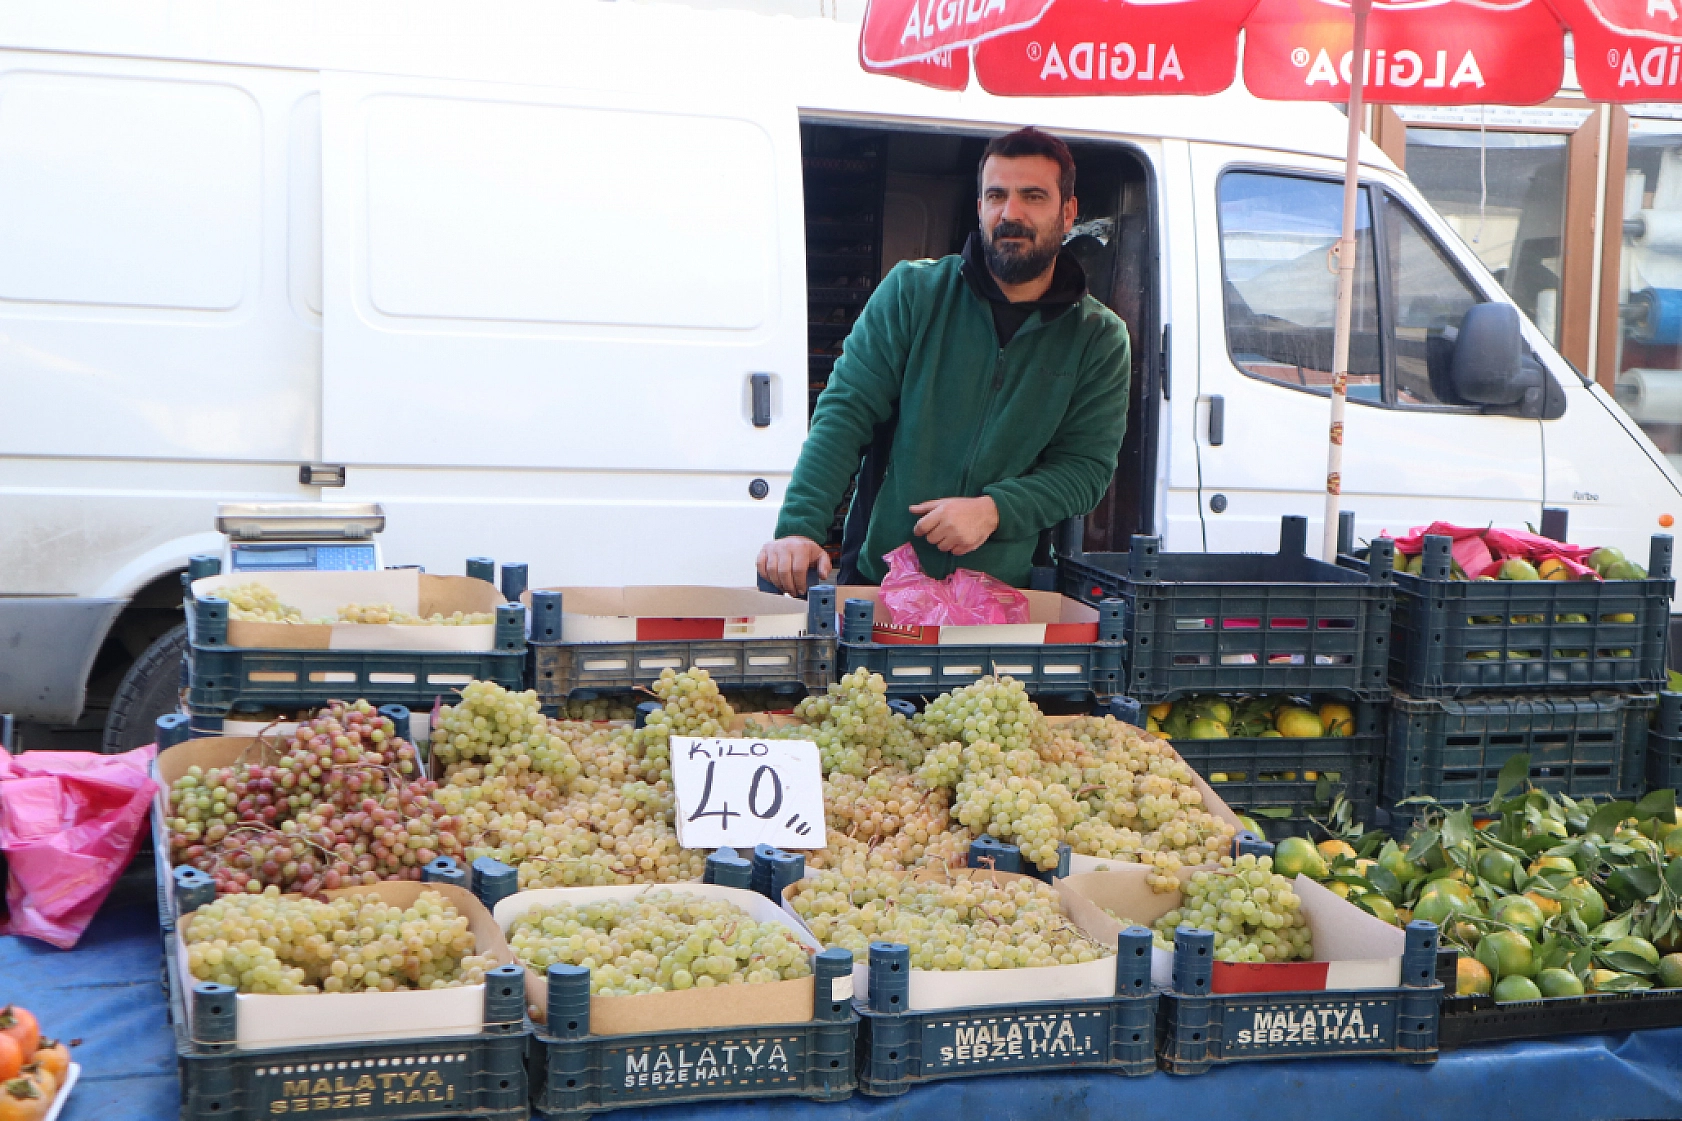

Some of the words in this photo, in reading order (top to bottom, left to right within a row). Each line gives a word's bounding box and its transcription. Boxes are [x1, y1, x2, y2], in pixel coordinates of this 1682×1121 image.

[1253, 1008, 1364, 1030] MALATYA
[955, 1019, 1075, 1046] MALATYA
[1237, 1026, 1319, 1044] SEBZE
[626, 1044, 788, 1073] MALATYA
[940, 1040, 1023, 1062] SEBZE
[282, 1070, 444, 1097] MALATYA
[624, 1068, 689, 1088] SEBZE
[270, 1092, 373, 1114] SEBZE
